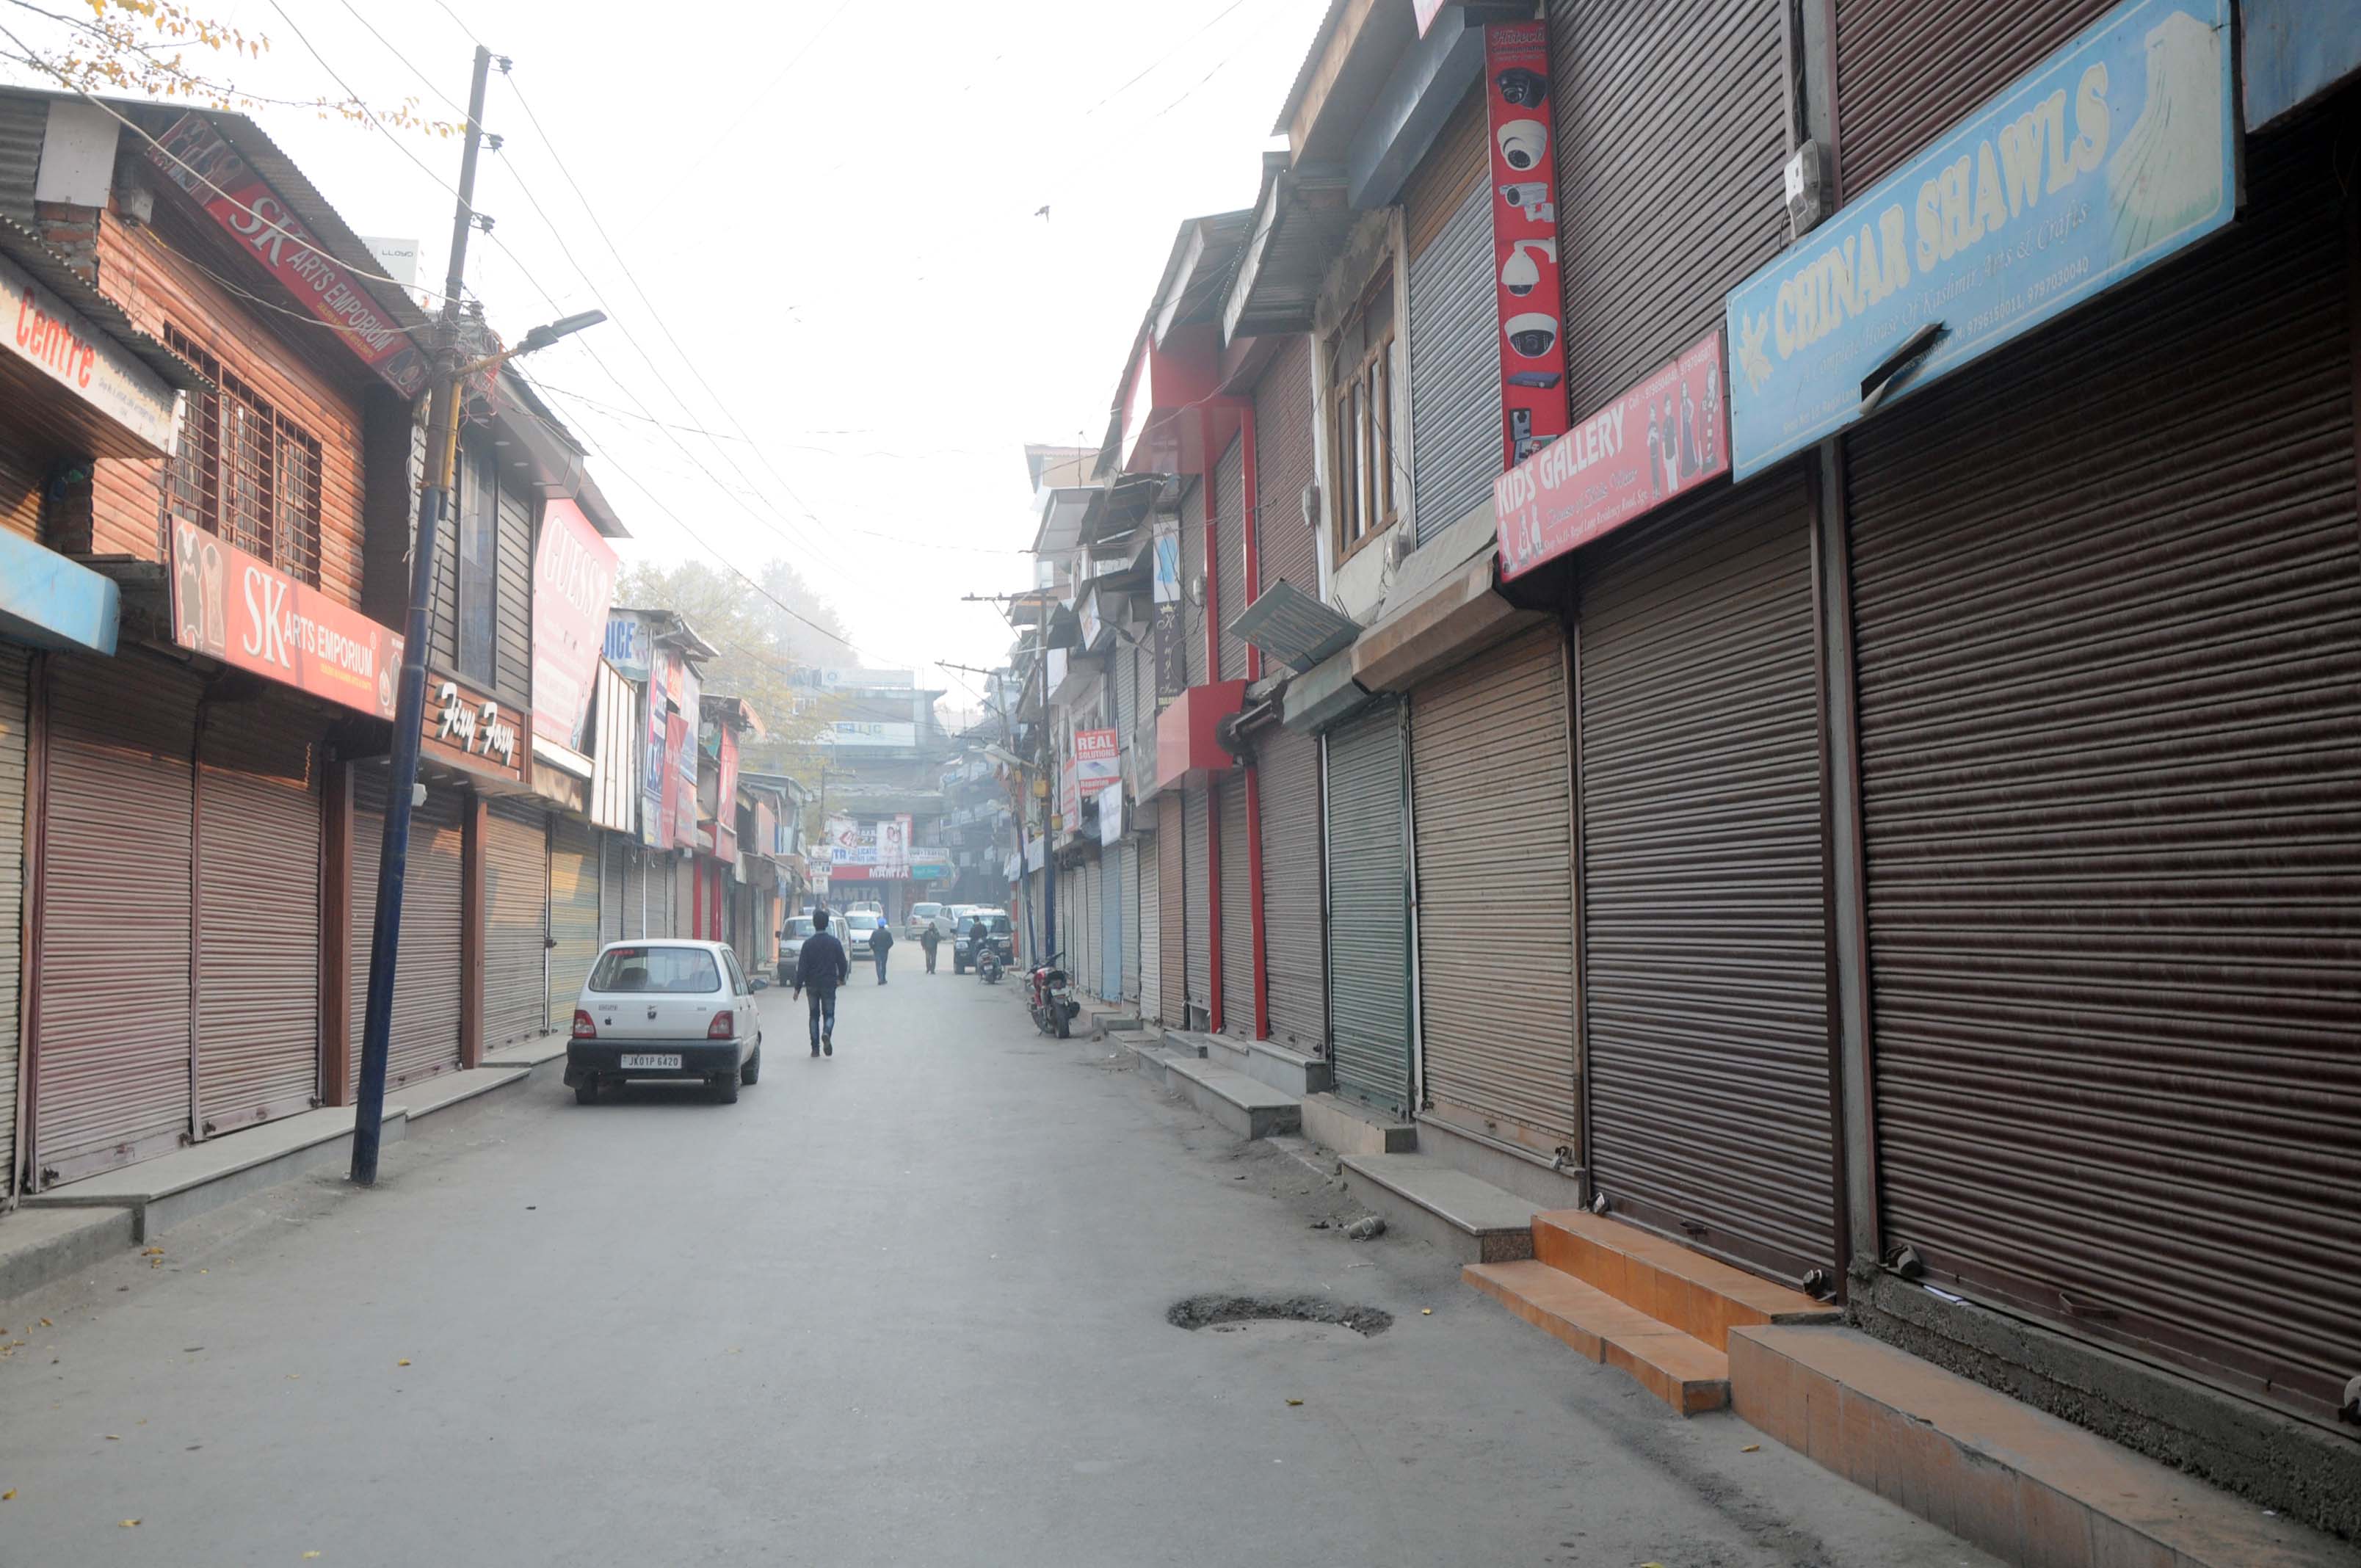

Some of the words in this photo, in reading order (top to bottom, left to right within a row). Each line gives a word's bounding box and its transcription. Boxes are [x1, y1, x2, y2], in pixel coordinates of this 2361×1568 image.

[1775, 204, 1910, 360] CHINAR
[1916, 61, 2109, 272] SHAWLS
[230, 197, 308, 267] SK
[286, 249, 335, 291] ARTS
[323, 283, 394, 352] EMPORIUM
[1863, 313, 1899, 346] House
[2037, 199, 2089, 250] Crafts
[16, 286, 95, 388] Centre
[1497, 461, 1537, 517] KIDS
[1539, 402, 1625, 490] GALLERY
[243, 566, 290, 669] SK
[284, 610, 315, 654] ARTS
[318, 625, 373, 679] EMPORIUM
[1078, 735, 1114, 750] REAL
[1078, 749, 1115, 759] SOLUTIONS
[830, 887, 881, 901] AMTA
[869, 868, 909, 879] MAMTA
[629, 1057, 655, 1066] JK01P
[657, 1057, 678, 1066] 6420
